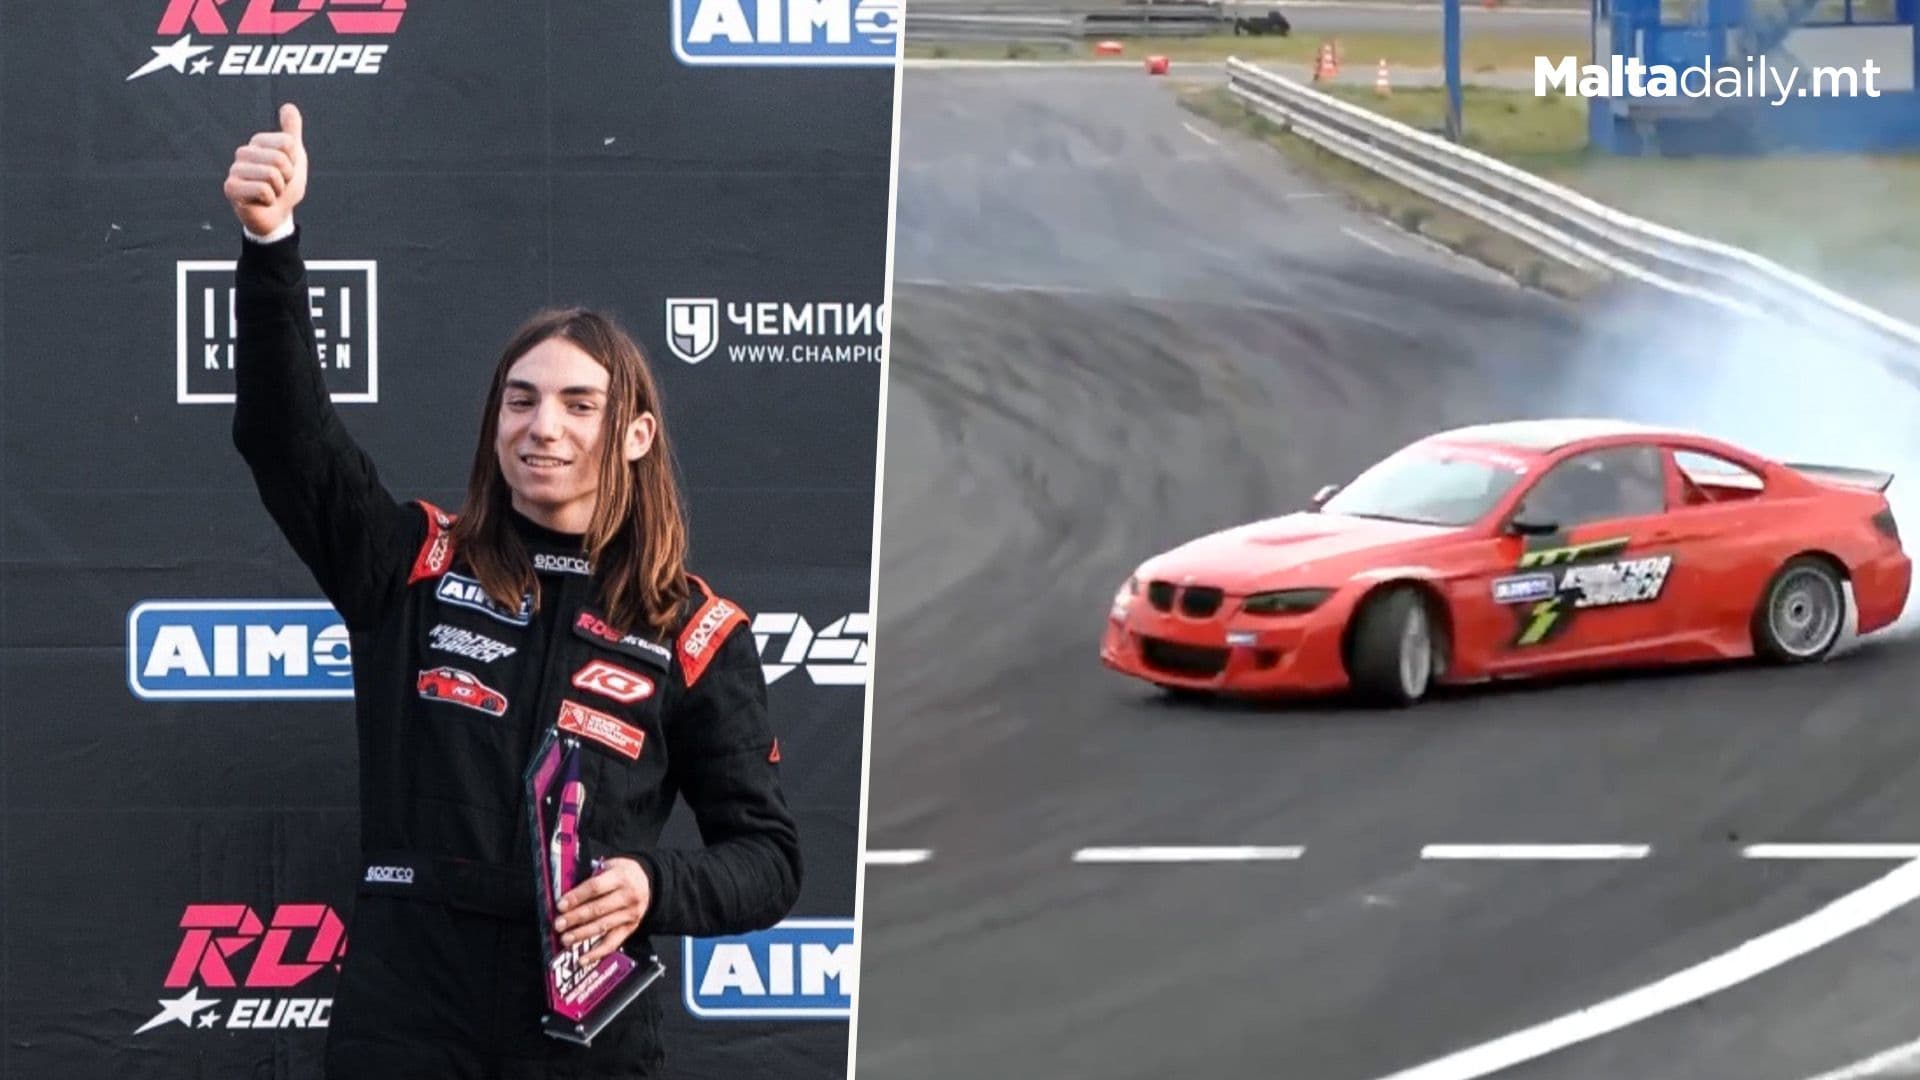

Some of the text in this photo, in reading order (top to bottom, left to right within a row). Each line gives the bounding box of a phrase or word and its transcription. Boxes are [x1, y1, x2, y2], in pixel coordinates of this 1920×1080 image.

[218, 45, 389, 75] EUROPE
[204, 344, 350, 369] KIEN
[163, 904, 348, 988] RD
